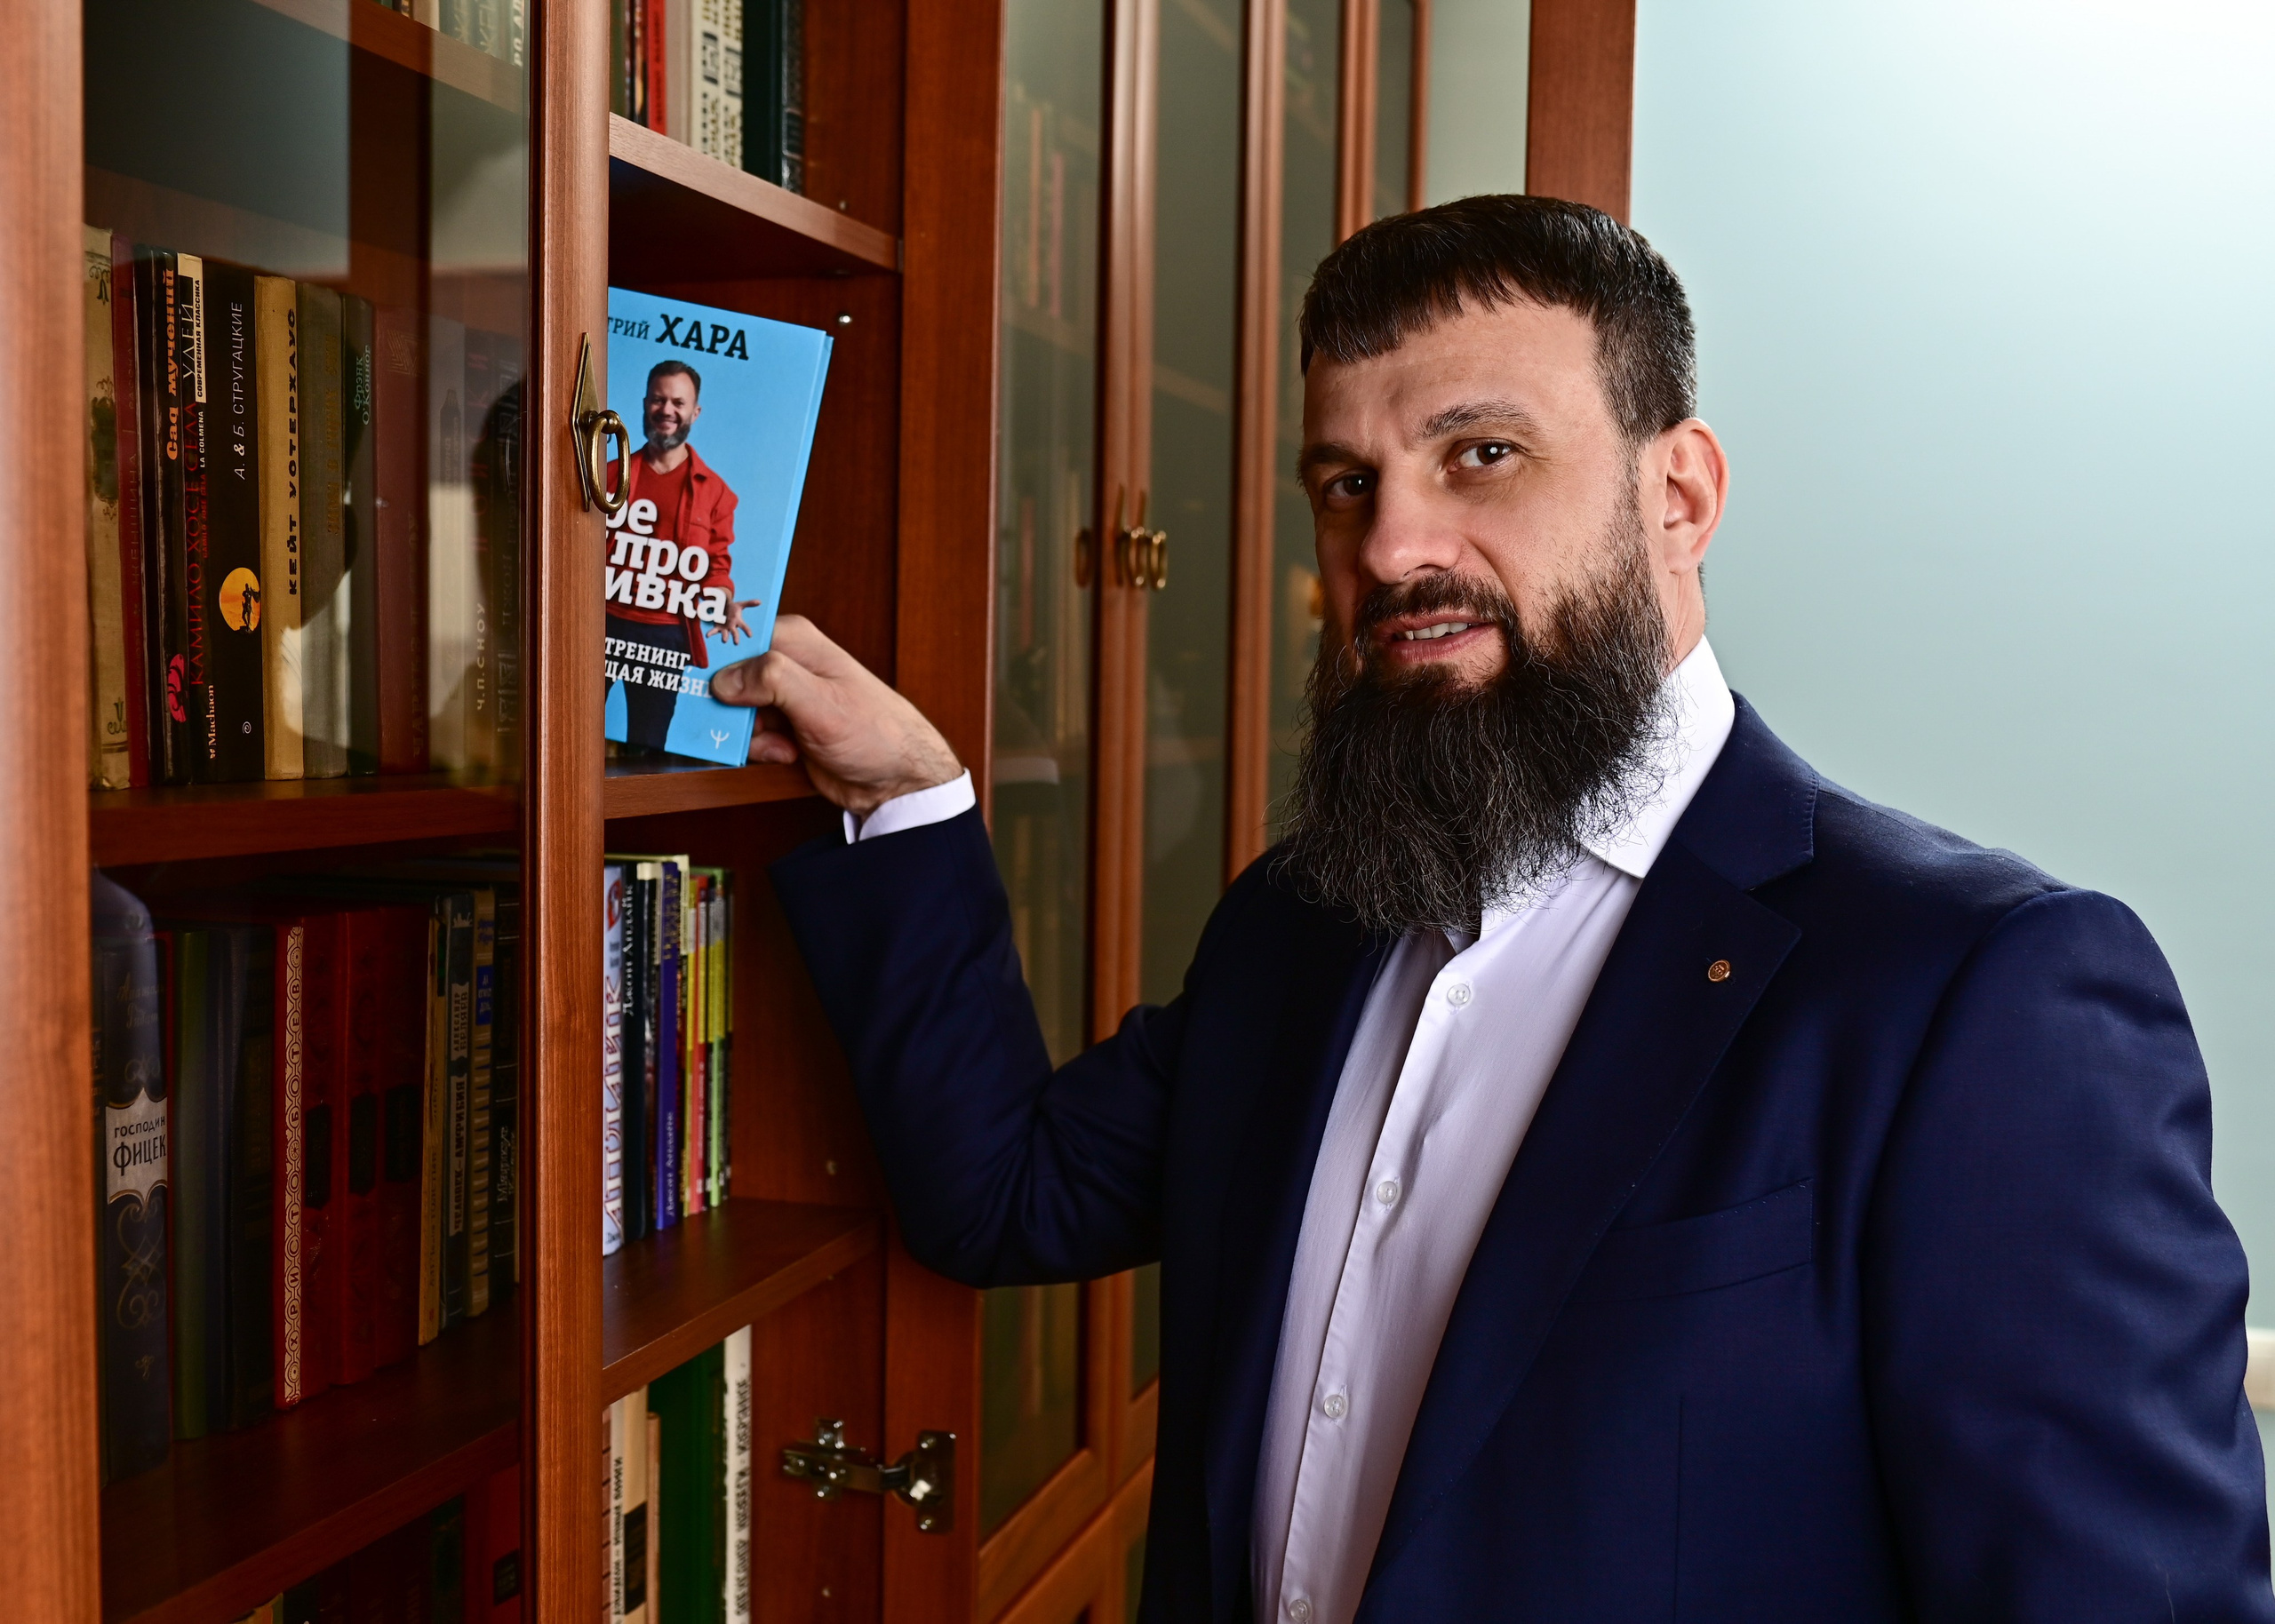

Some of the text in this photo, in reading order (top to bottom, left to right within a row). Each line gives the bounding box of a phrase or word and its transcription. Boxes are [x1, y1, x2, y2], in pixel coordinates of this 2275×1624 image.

[163, 269, 178, 460] Сад мучений
[180, 302, 196, 379] УЛЕЙ
[194, 330, 204, 397] СОВРЕМЕННАЯ
[230, 302, 244, 415] СТРУГАЦКИЕ
[655, 314, 749, 361] ХАРА
[353, 355, 364, 410] Фрэнк
[362, 344, 371, 426] О'Коннор
[199, 455, 206, 468] LA
[233, 444, 245, 457] &
[285, 307, 298, 596] КЕЙТ УОТЕРХАУС
[183, 402, 204, 686] КАМИЛО ХОСЕ СЕЛА
[610, 530, 709, 582] про
[605, 566, 727, 625] ивка
[604, 636, 691, 673] ТРЕНИНГ,
[205, 684, 216, 748] Machaon
[113, 1134, 166, 1176] ФИЦЕК
[289, 981, 301, 1347] ХРИСТО БОТЕВ
